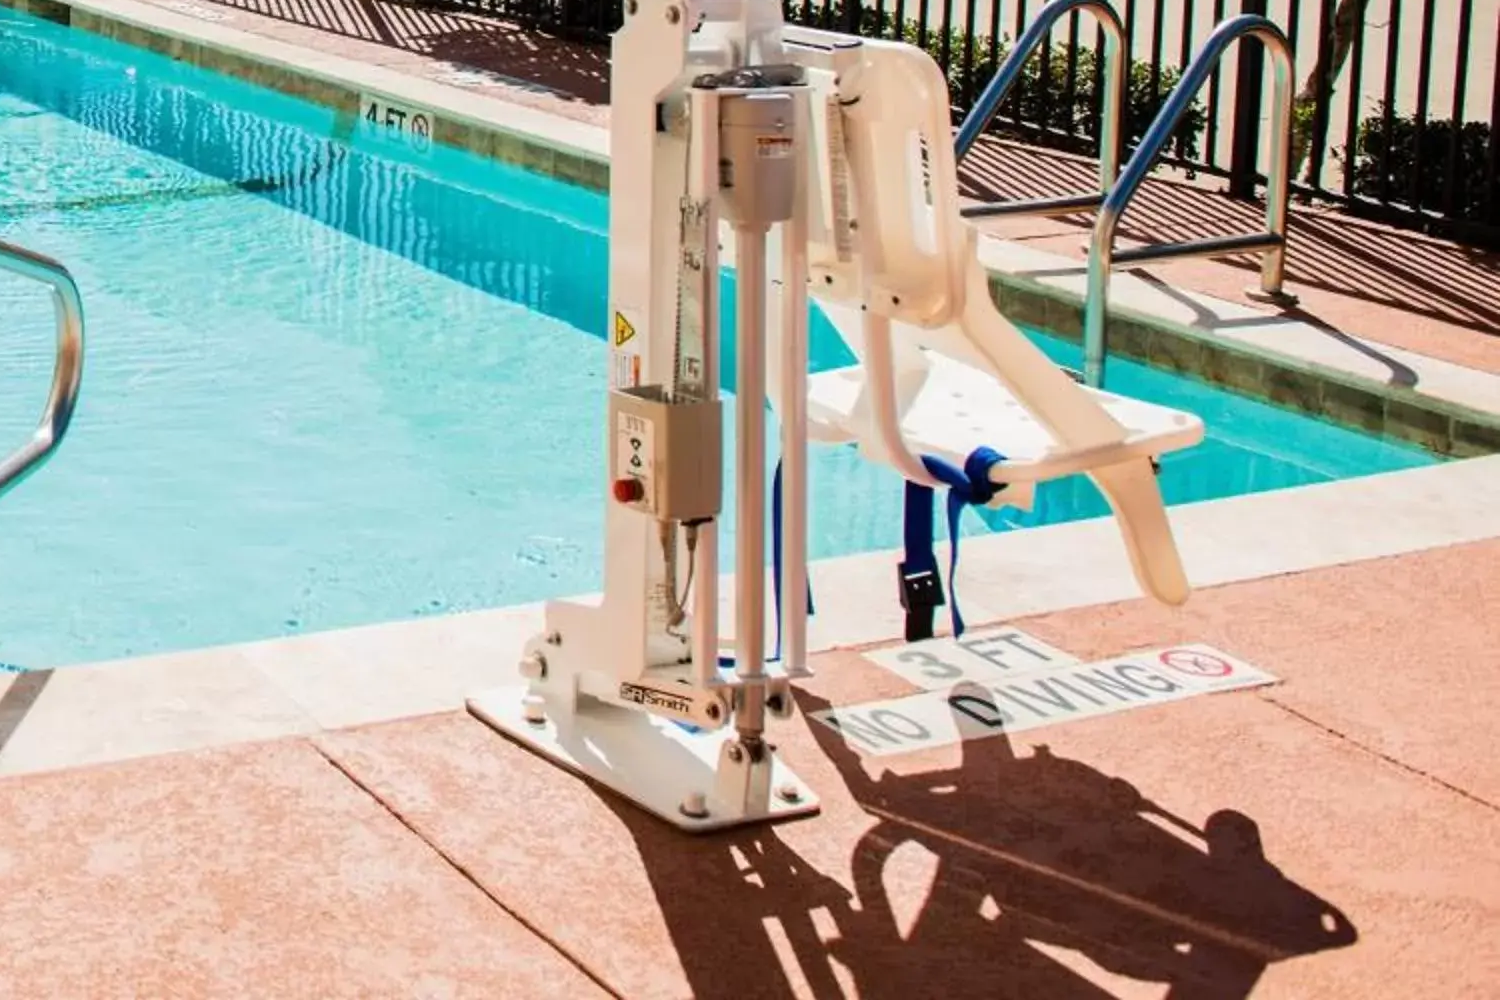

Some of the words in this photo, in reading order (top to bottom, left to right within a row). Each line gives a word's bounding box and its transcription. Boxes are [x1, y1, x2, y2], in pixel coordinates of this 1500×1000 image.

[386, 107, 407, 130] FT
[896, 651, 963, 679] 3
[956, 632, 1053, 670] FT
[825, 709, 932, 748] NO
[948, 655, 1183, 728] DIVING
